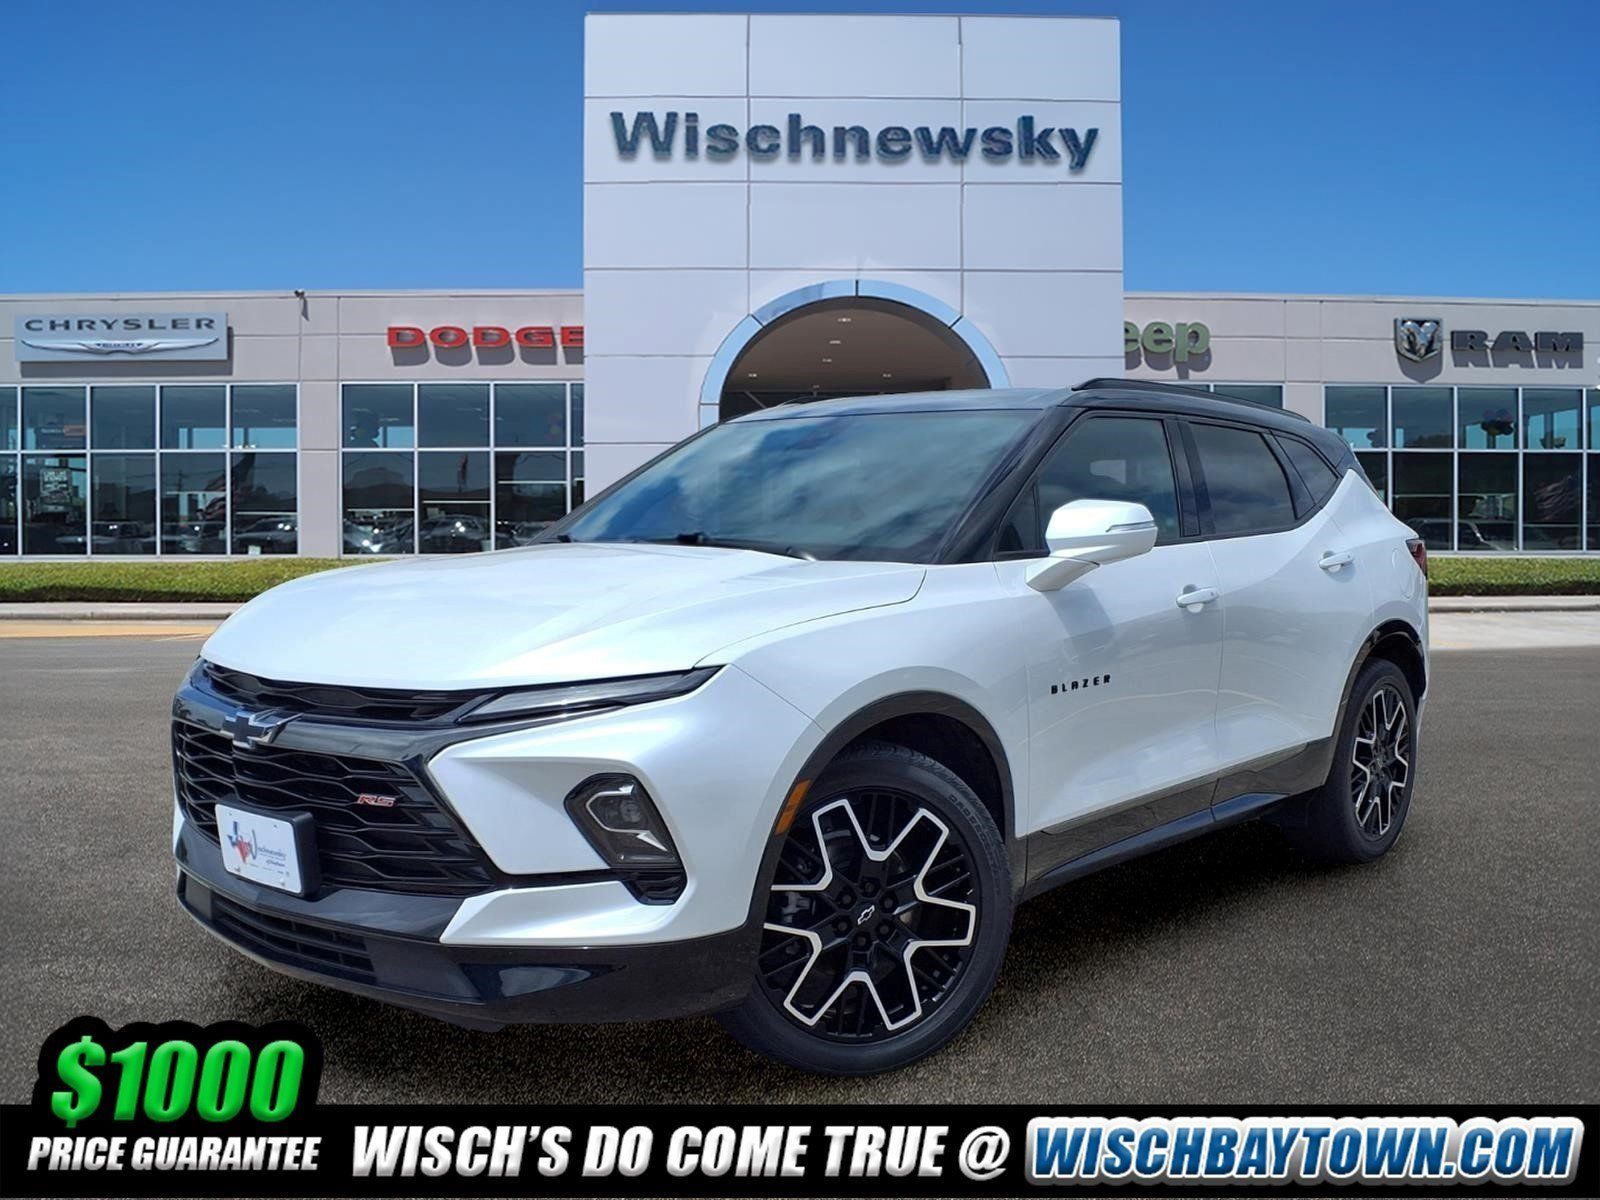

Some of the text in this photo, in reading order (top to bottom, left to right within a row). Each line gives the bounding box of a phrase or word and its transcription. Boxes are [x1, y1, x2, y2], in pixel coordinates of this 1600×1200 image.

[610, 111, 1099, 171] Wischnewsky
[24, 318, 215, 331] CHRYSLER
[387, 326, 584, 347] DODGE
[1450, 330, 1584, 351] RAM
[1051, 674, 1111, 695] BLAZER
[357, 793, 396, 807] RS
